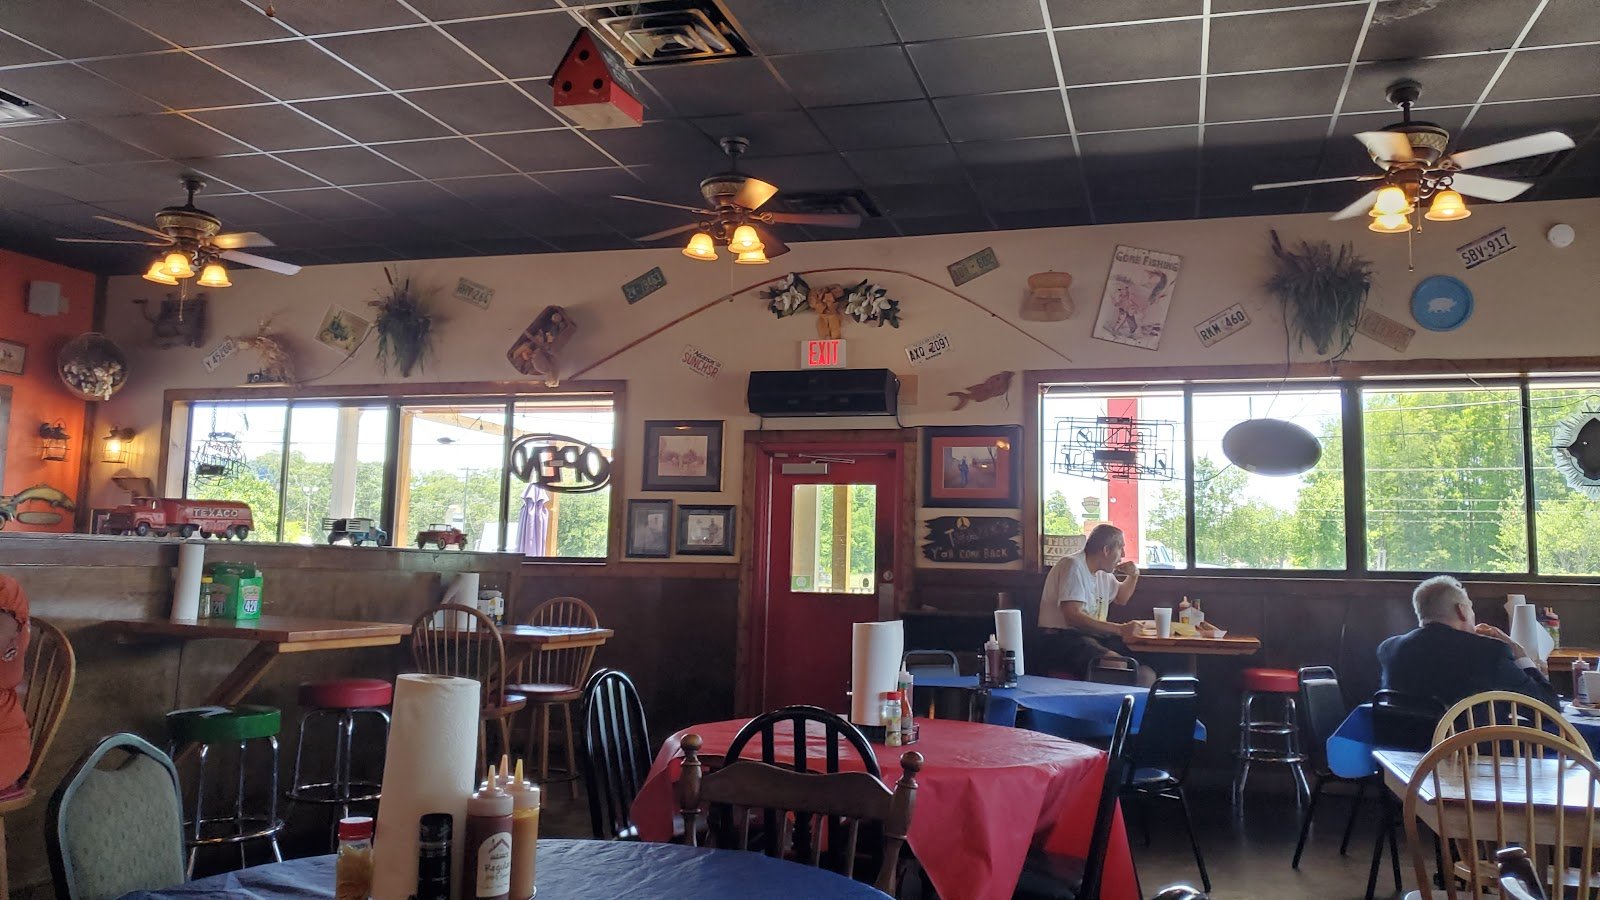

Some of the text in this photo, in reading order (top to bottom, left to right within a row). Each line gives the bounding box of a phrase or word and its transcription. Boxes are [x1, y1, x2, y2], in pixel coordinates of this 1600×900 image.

[1461, 232, 1511, 265] SBV 917
[1225, 310, 1245, 327] 460
[808, 340, 839, 366] EXIT
[928, 336, 950, 353] 2091
[193, 507, 239, 518] TEXACO
